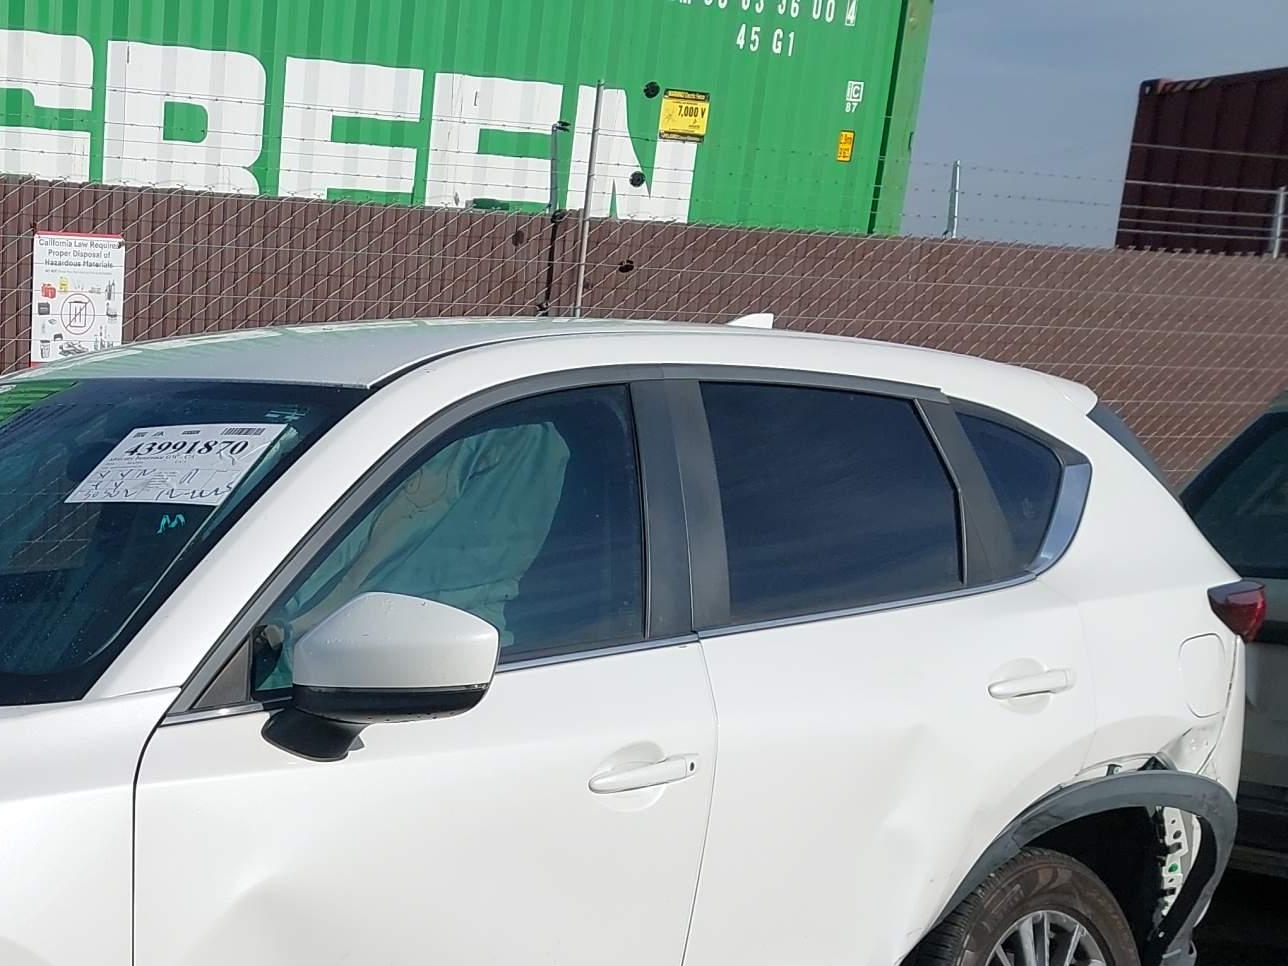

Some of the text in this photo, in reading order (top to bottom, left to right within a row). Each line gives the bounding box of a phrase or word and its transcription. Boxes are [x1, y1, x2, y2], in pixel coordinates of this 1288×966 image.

[736, 24, 795, 56] 45 G1
[39, 239, 73, 248] California
[74, 240, 88, 248] Law
[48, 249, 111, 259] Proper Disposal of
[44, 259, 113, 269] Hazardous Materials
[124, 440, 249, 456] 43991870
